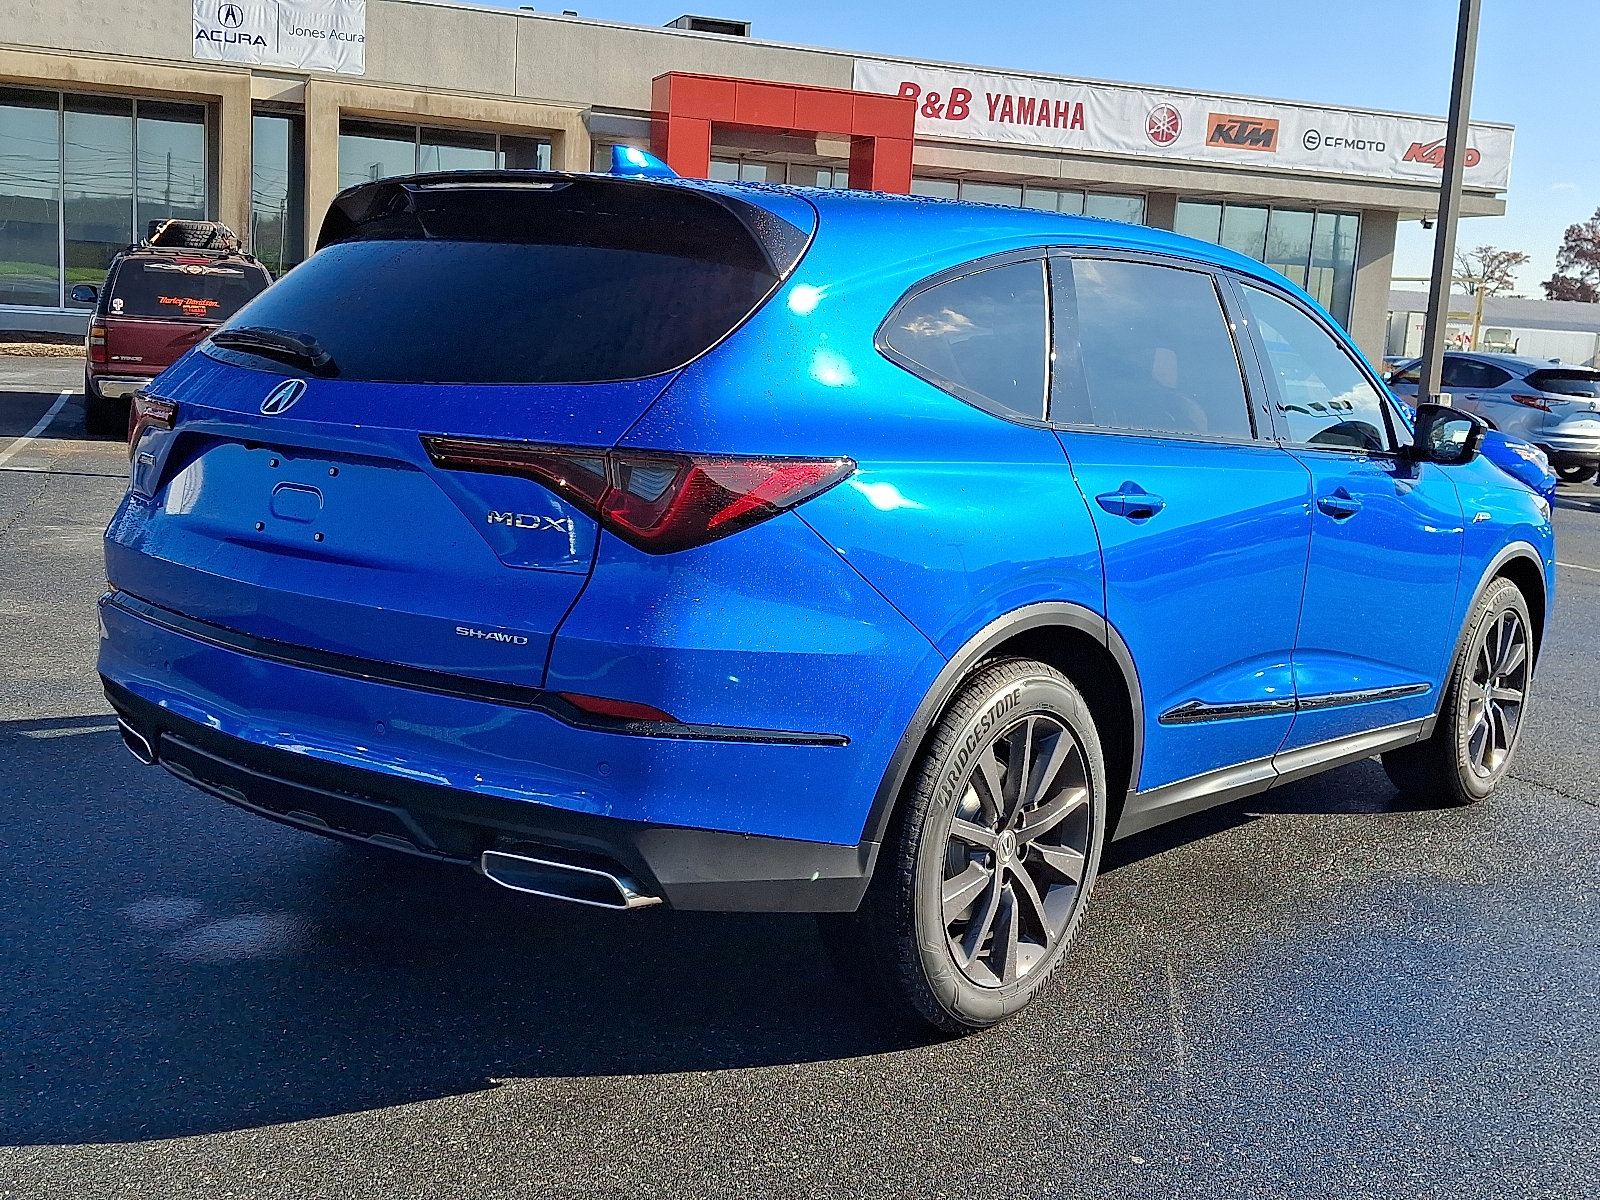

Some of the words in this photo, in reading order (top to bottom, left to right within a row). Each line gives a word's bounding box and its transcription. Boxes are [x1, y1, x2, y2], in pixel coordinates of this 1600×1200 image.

[195, 29, 267, 47] ACURA
[288, 25, 326, 39] Jones
[329, 29, 365, 43] Acura
[986, 92, 1085, 131] YAMAHA
[1209, 119, 1276, 148] KTM
[1324, 136, 1386, 152] CFMOTO
[1402, 137, 1481, 168] KAO
[158, 296, 220, 307] Harley-Davidson
[487, 510, 568, 533] MDX
[937, 688, 1021, 810] BRIDGESTONE
